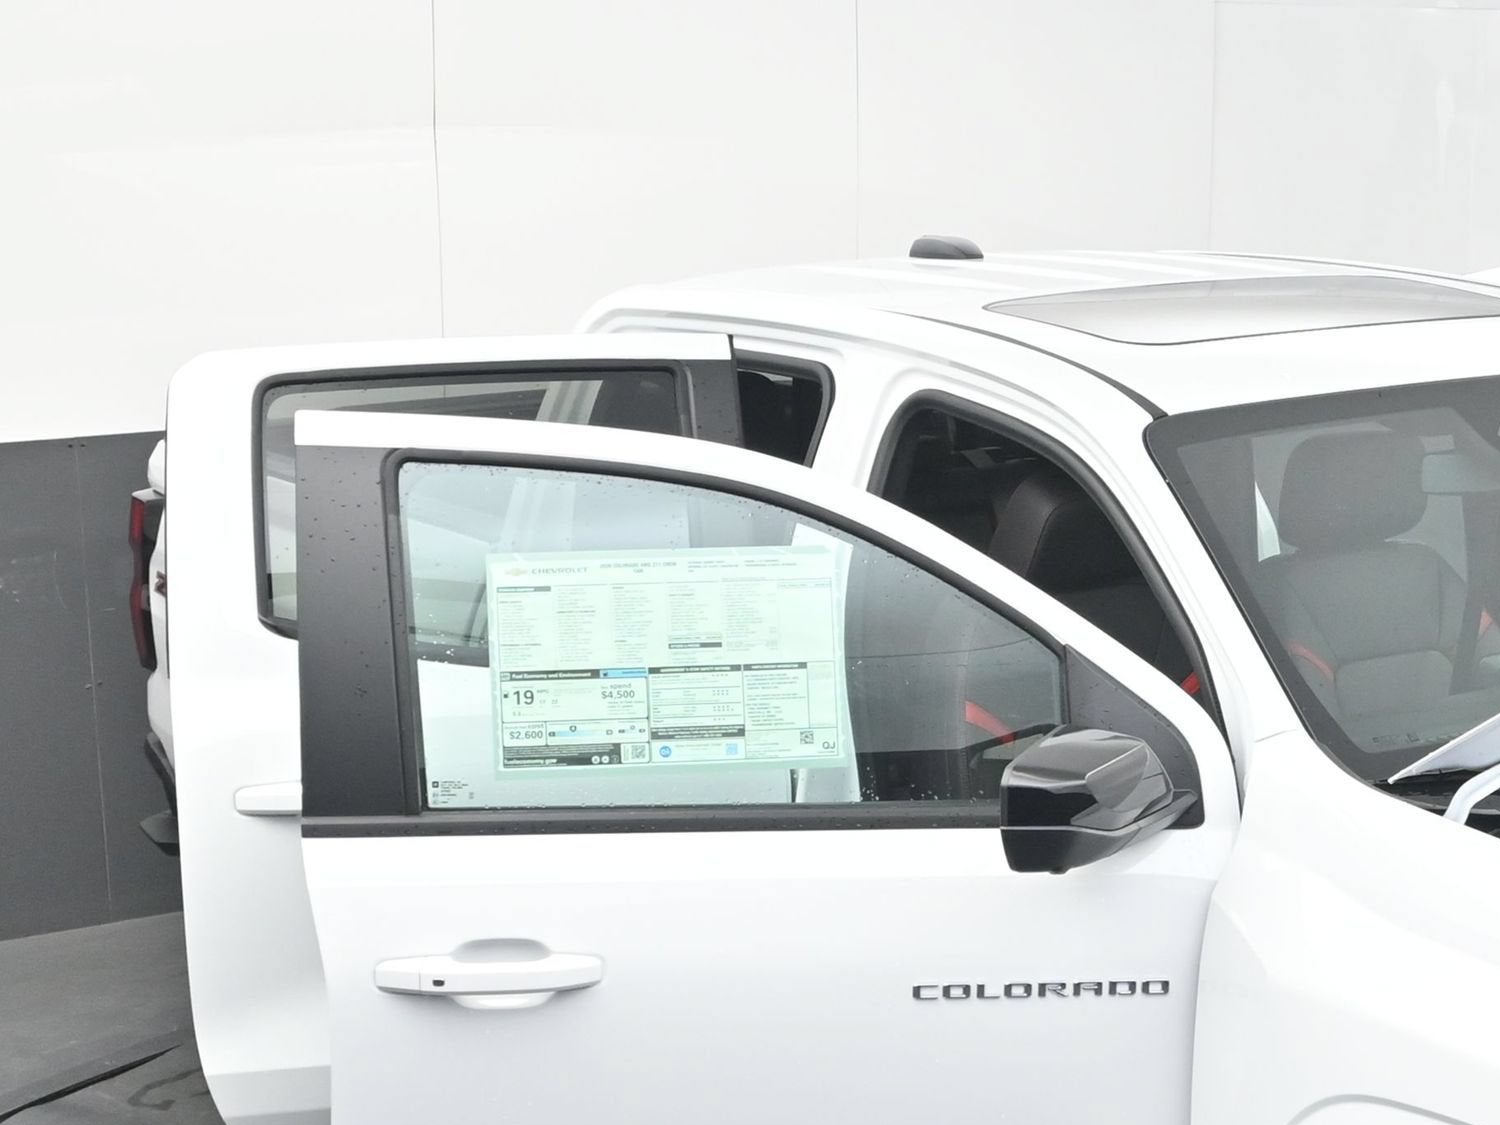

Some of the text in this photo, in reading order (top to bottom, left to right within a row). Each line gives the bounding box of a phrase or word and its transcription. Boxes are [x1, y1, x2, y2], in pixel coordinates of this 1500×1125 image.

[531, 566, 588, 575] CHEVROLET
[512, 689, 535, 706] 19
[601, 689, 636, 700] $4,500
[822, 741, 836, 750] QJ
[912, 980, 1170, 1000] COLORADO
